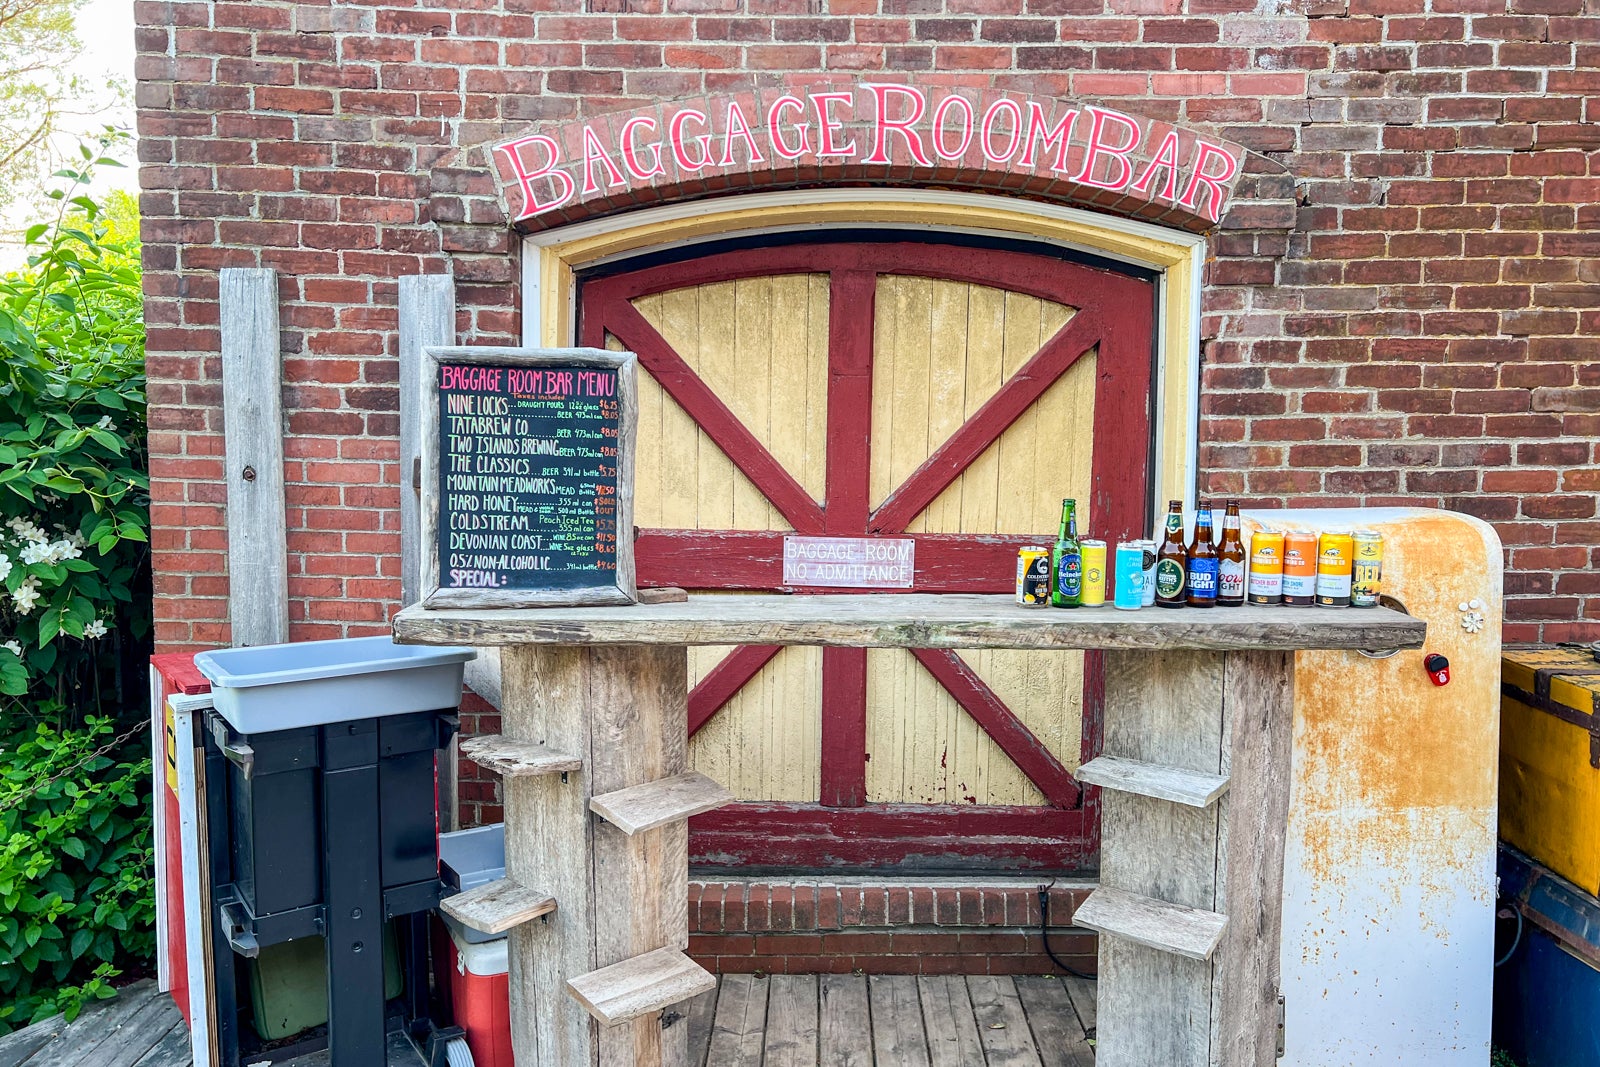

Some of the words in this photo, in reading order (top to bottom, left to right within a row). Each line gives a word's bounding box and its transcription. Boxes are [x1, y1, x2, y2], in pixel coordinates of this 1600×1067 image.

[493, 92, 857, 222] BAGGAGE
[859, 83, 1079, 172] ROOM
[1069, 105, 1237, 223] BAR
[440, 366, 502, 392] BAGGAGE
[508, 369, 542, 394] ROOM
[544, 371, 573, 396] BAR
[578, 371, 615, 396] MENU
[448, 394, 476, 414] NINE
[447, 416, 512, 435] TATABREW
[556, 429, 572, 438] BEER
[448, 434, 472, 453] TWO
[475, 436, 520, 455] ISLANDS
[521, 438, 560, 456] BREWING
[560, 448, 576, 456] BEER
[448, 454, 471, 472] THE
[476, 455, 530, 475] CLASSICS
[542, 468, 559, 476] BEER
[447, 474, 499, 492] MOUNTAIN
[500, 476, 556, 494] MEADWORKS
[556, 486, 575, 495] MEAD
[448, 494, 479, 511] HARD
[483, 495, 518, 512] HONEY
[539, 515, 560, 524] Peach
[560, 515, 579, 524] Iced
[450, 532, 507, 550] DEVONIAN
[511, 534, 542, 550] COAST
[787, 543, 857, 560] BAGGAGE
[866, 545, 910, 561] ROOM
[786, 563, 808, 580] NO
[815, 564, 908, 582] ADMITTANCE
